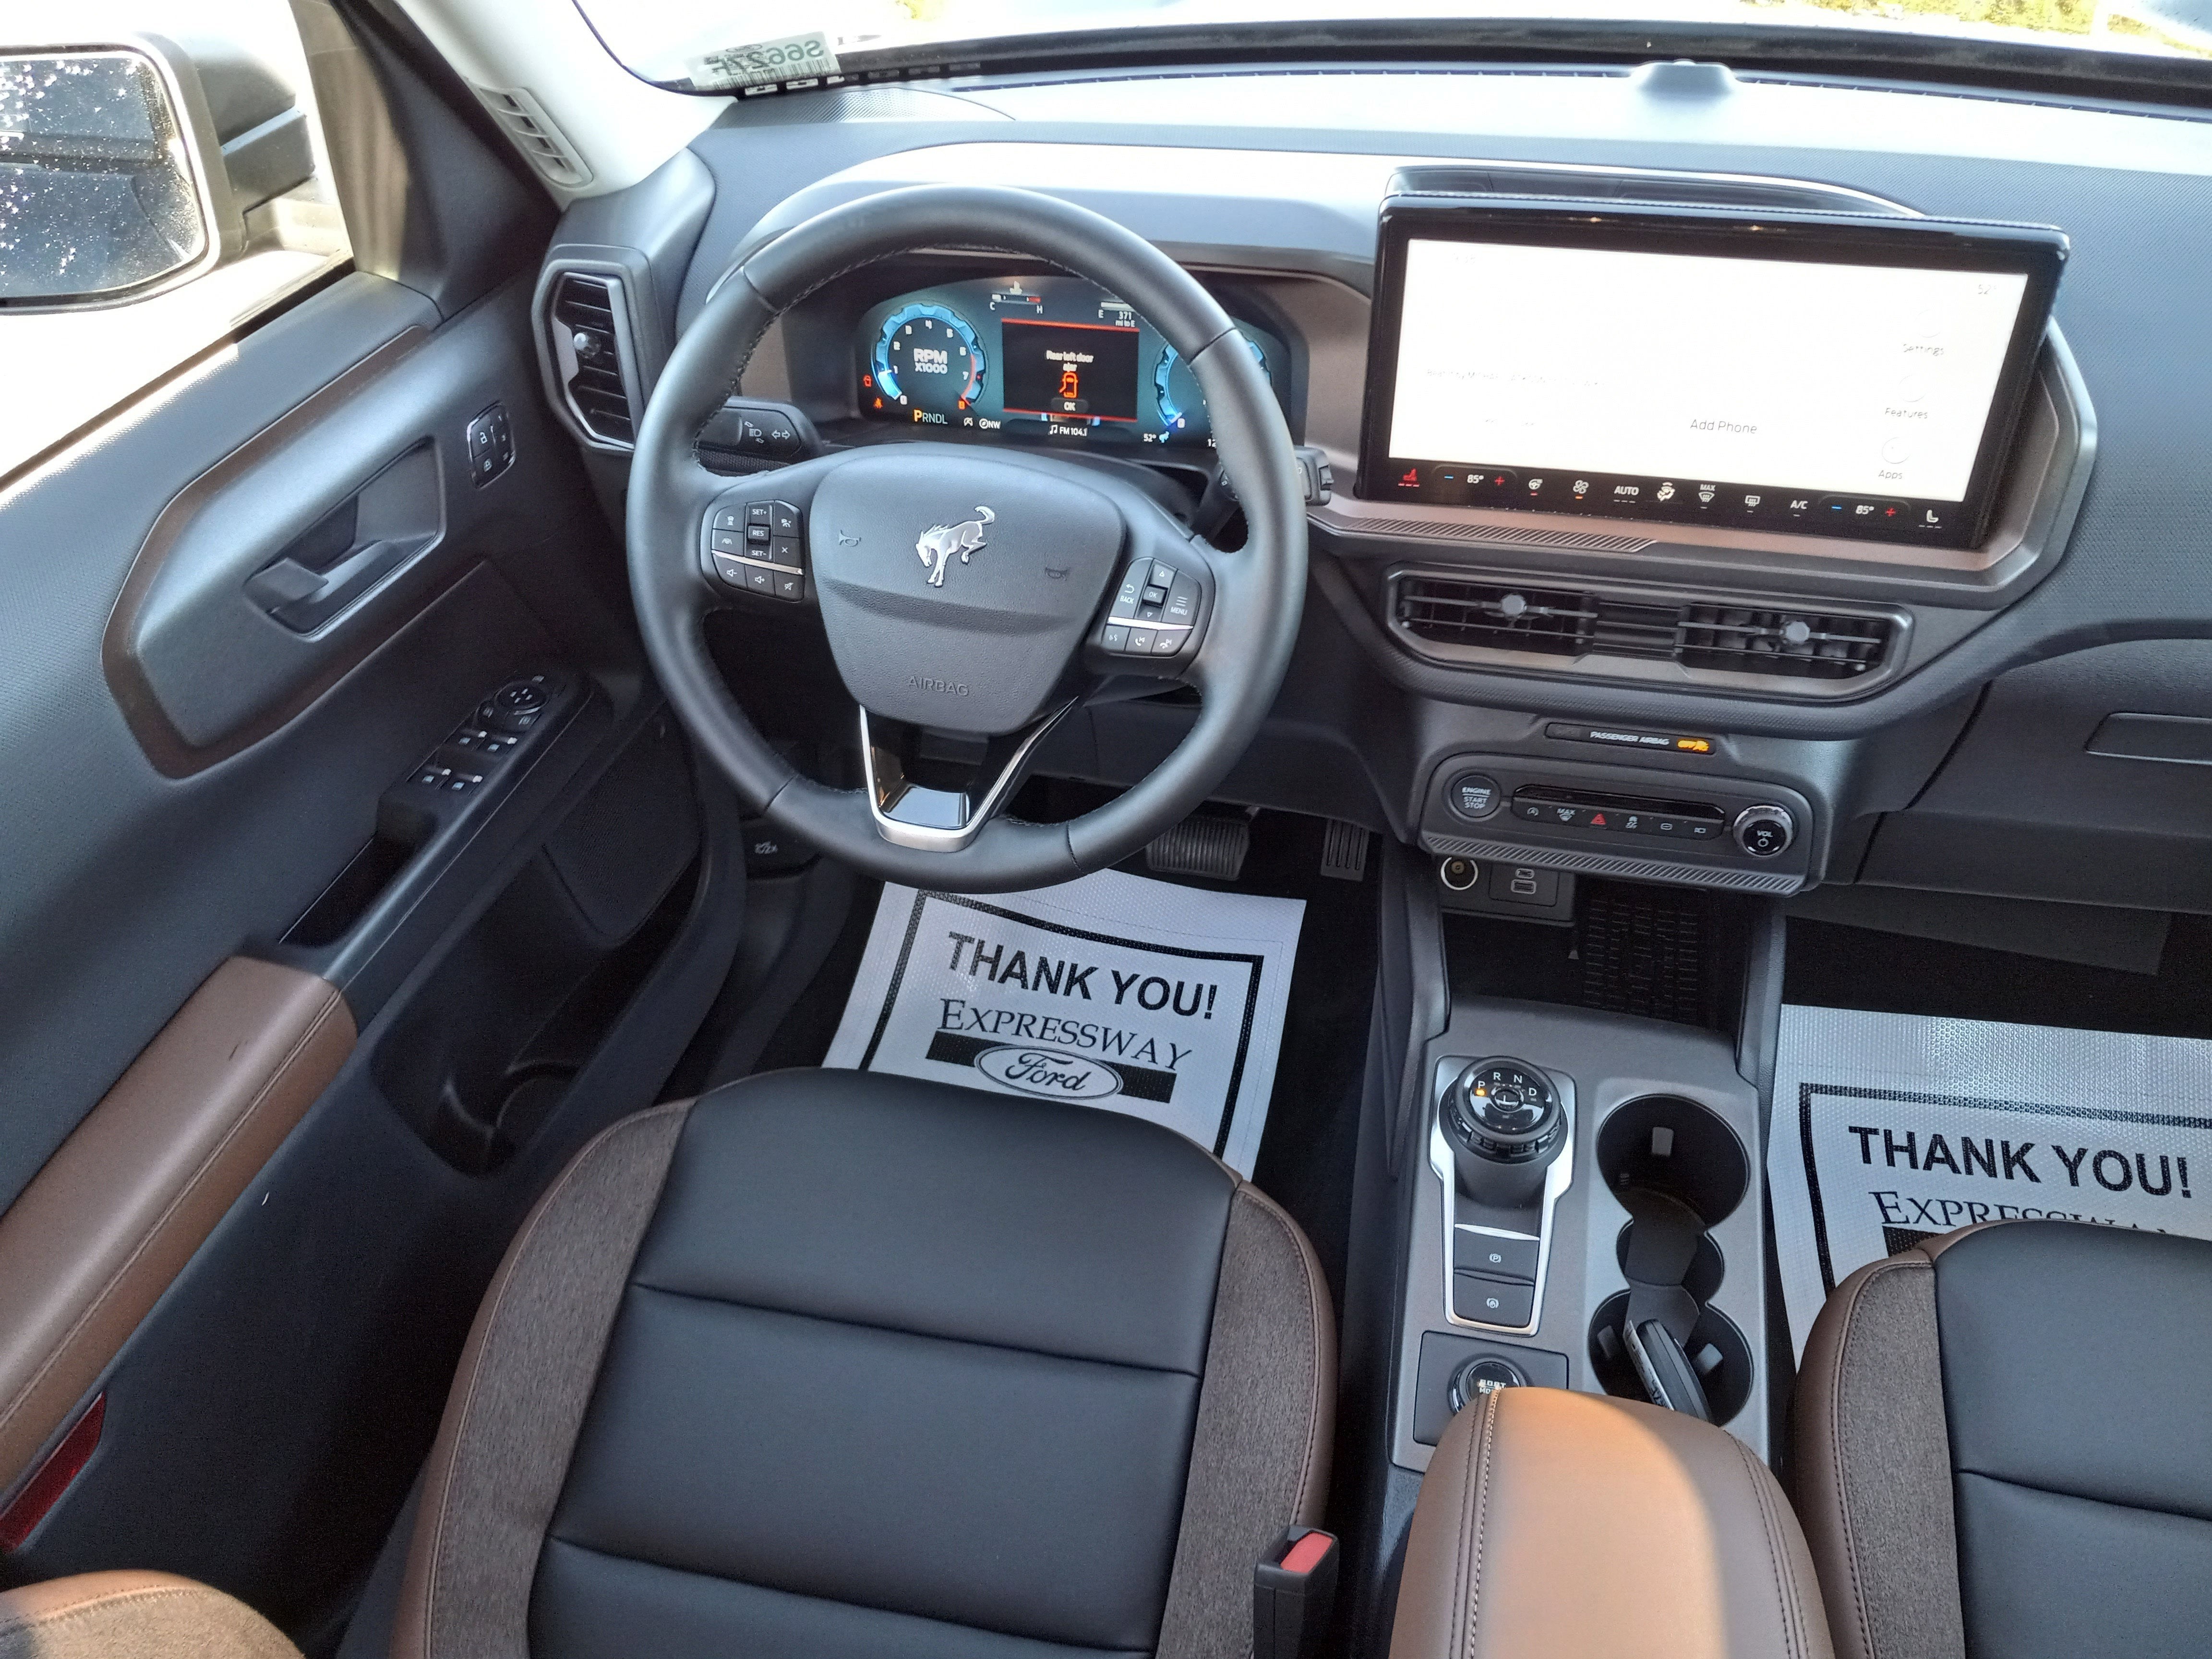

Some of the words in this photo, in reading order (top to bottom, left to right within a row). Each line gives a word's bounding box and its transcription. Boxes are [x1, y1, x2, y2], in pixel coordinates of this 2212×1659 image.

[990, 302, 995, 310] C
[1036, 305, 1043, 313] H
[1098, 309, 1104, 318] E
[1119, 311, 1131, 320] 371
[893, 341, 901, 350] 2
[1903, 343, 1945, 356] Settings
[914, 348, 948, 364] RPM
[1046, 350, 1063, 361] Rear
[1076, 352, 1094, 363] door
[894, 365, 898, 374] 1
[915, 362, 948, 374] X1000
[962, 371, 969, 380] 7
[900, 395, 907, 405] 0
[1064, 402, 1075, 411] OK
[1885, 408, 1928, 419] Features
[988, 420, 1001, 429] NW
[1178, 418, 1185, 428] 0
[1690, 419, 1714, 431] Add
[1718, 421, 1757, 434] Phone
[1059, 427, 1070, 435] FM
[1071, 428, 1087, 436] 104.1
[1878, 470, 1903, 480] Apps
[1614, 485, 1639, 495] AUTO
[1791, 500, 1808, 510] A/C
[1120, 595, 1134, 604] BACK
[1170, 606, 1188, 615] MENU
[909, 675, 969, 697] AIRBAG
[1590, 731, 1638, 743] PASSENGER
[1639, 736, 1670, 745] AIRBAG
[1462, 786, 1491, 795] ENGINE
[948, 931, 1099, 1001] THANK
[1111, 968, 1217, 1019] YOU!
[937, 998, 1193, 1071] EXPRESSWAY
[1005, 1051, 1091, 1092] Ford
[1493, 1072, 1501, 1081] R
[1514, 1074, 1522, 1083] N
[1478, 1081, 1485, 1089] P
[1528, 1088, 1537, 1096] D
[1849, 1126, 2042, 1184] THANK
[2051, 1143, 2192, 1199] YOU!
